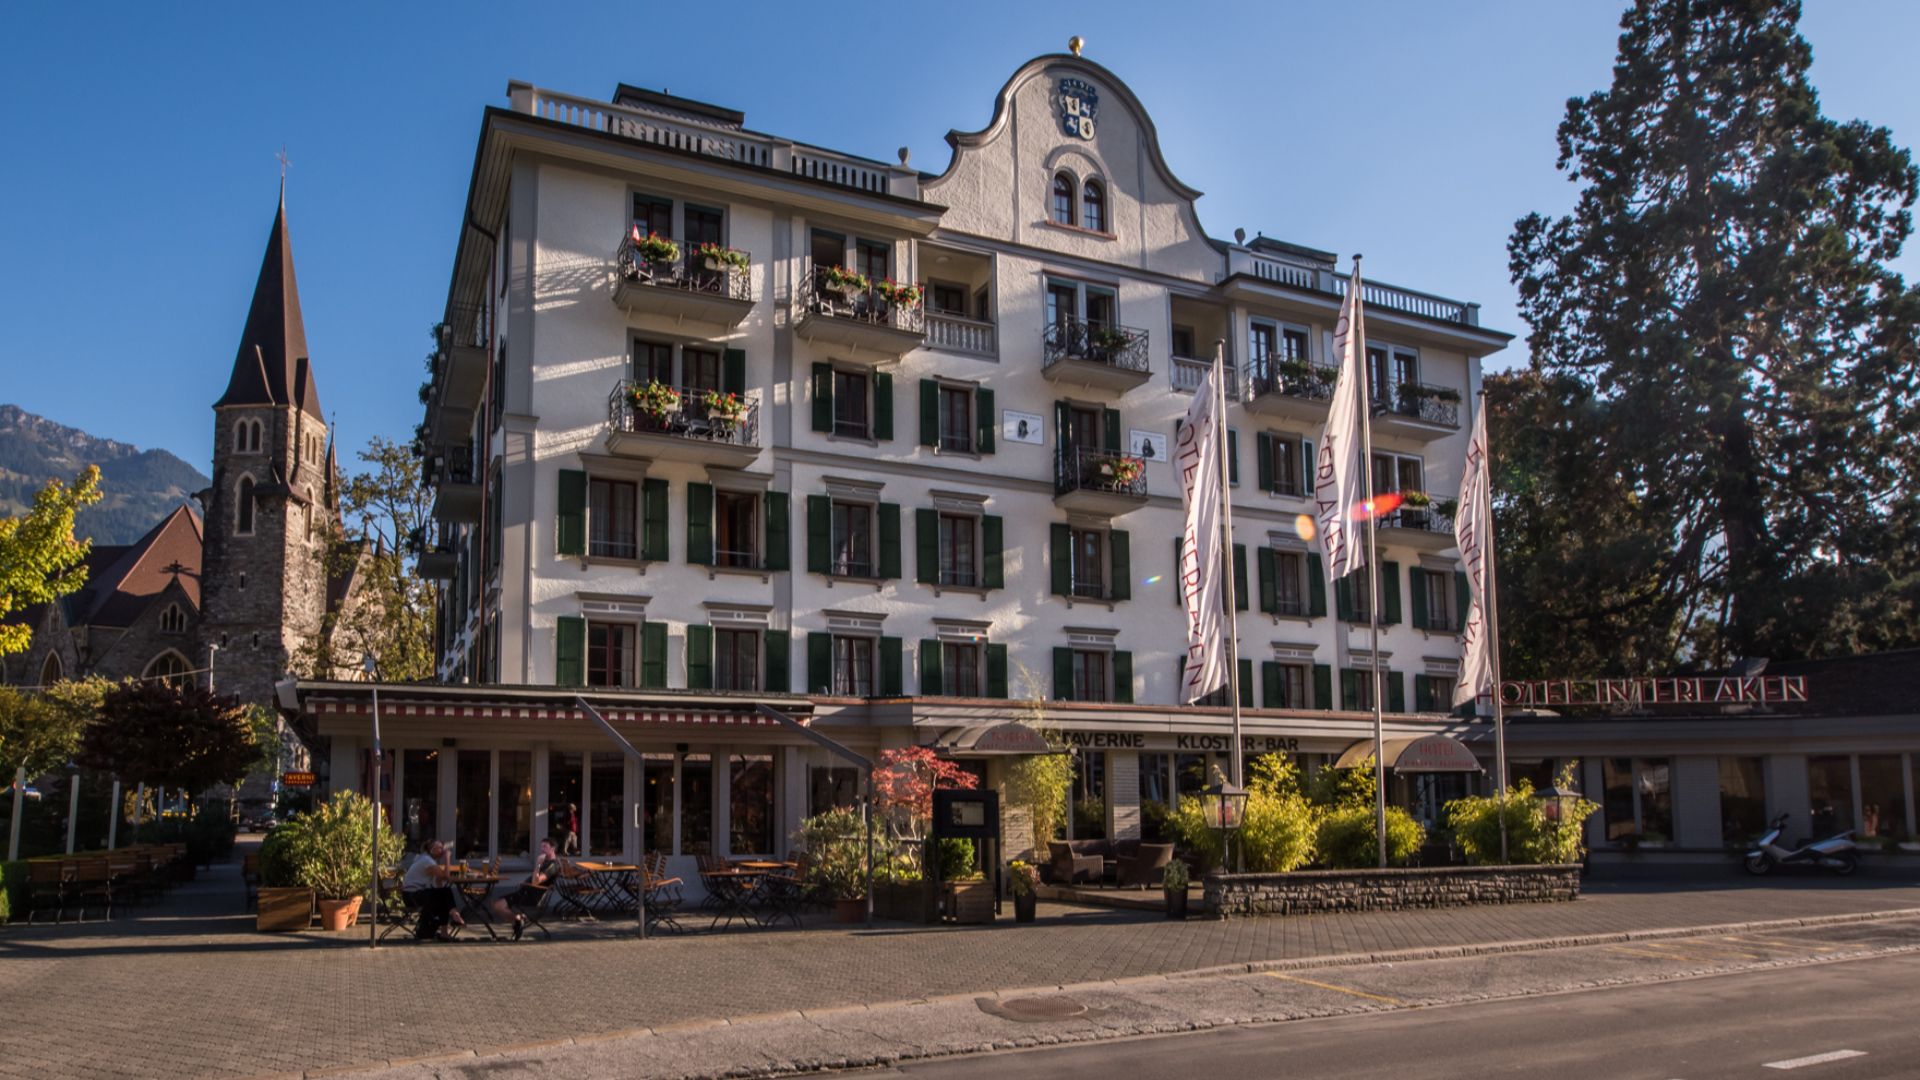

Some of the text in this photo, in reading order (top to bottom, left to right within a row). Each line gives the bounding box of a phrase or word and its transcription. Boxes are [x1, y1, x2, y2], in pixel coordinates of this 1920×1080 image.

[1476, 675, 1809, 705] HOTEL INTERLAKEN
[1062, 732, 1145, 748] TAVERNE
[1177, 735, 1299, 751] KLOSTR-BAR
